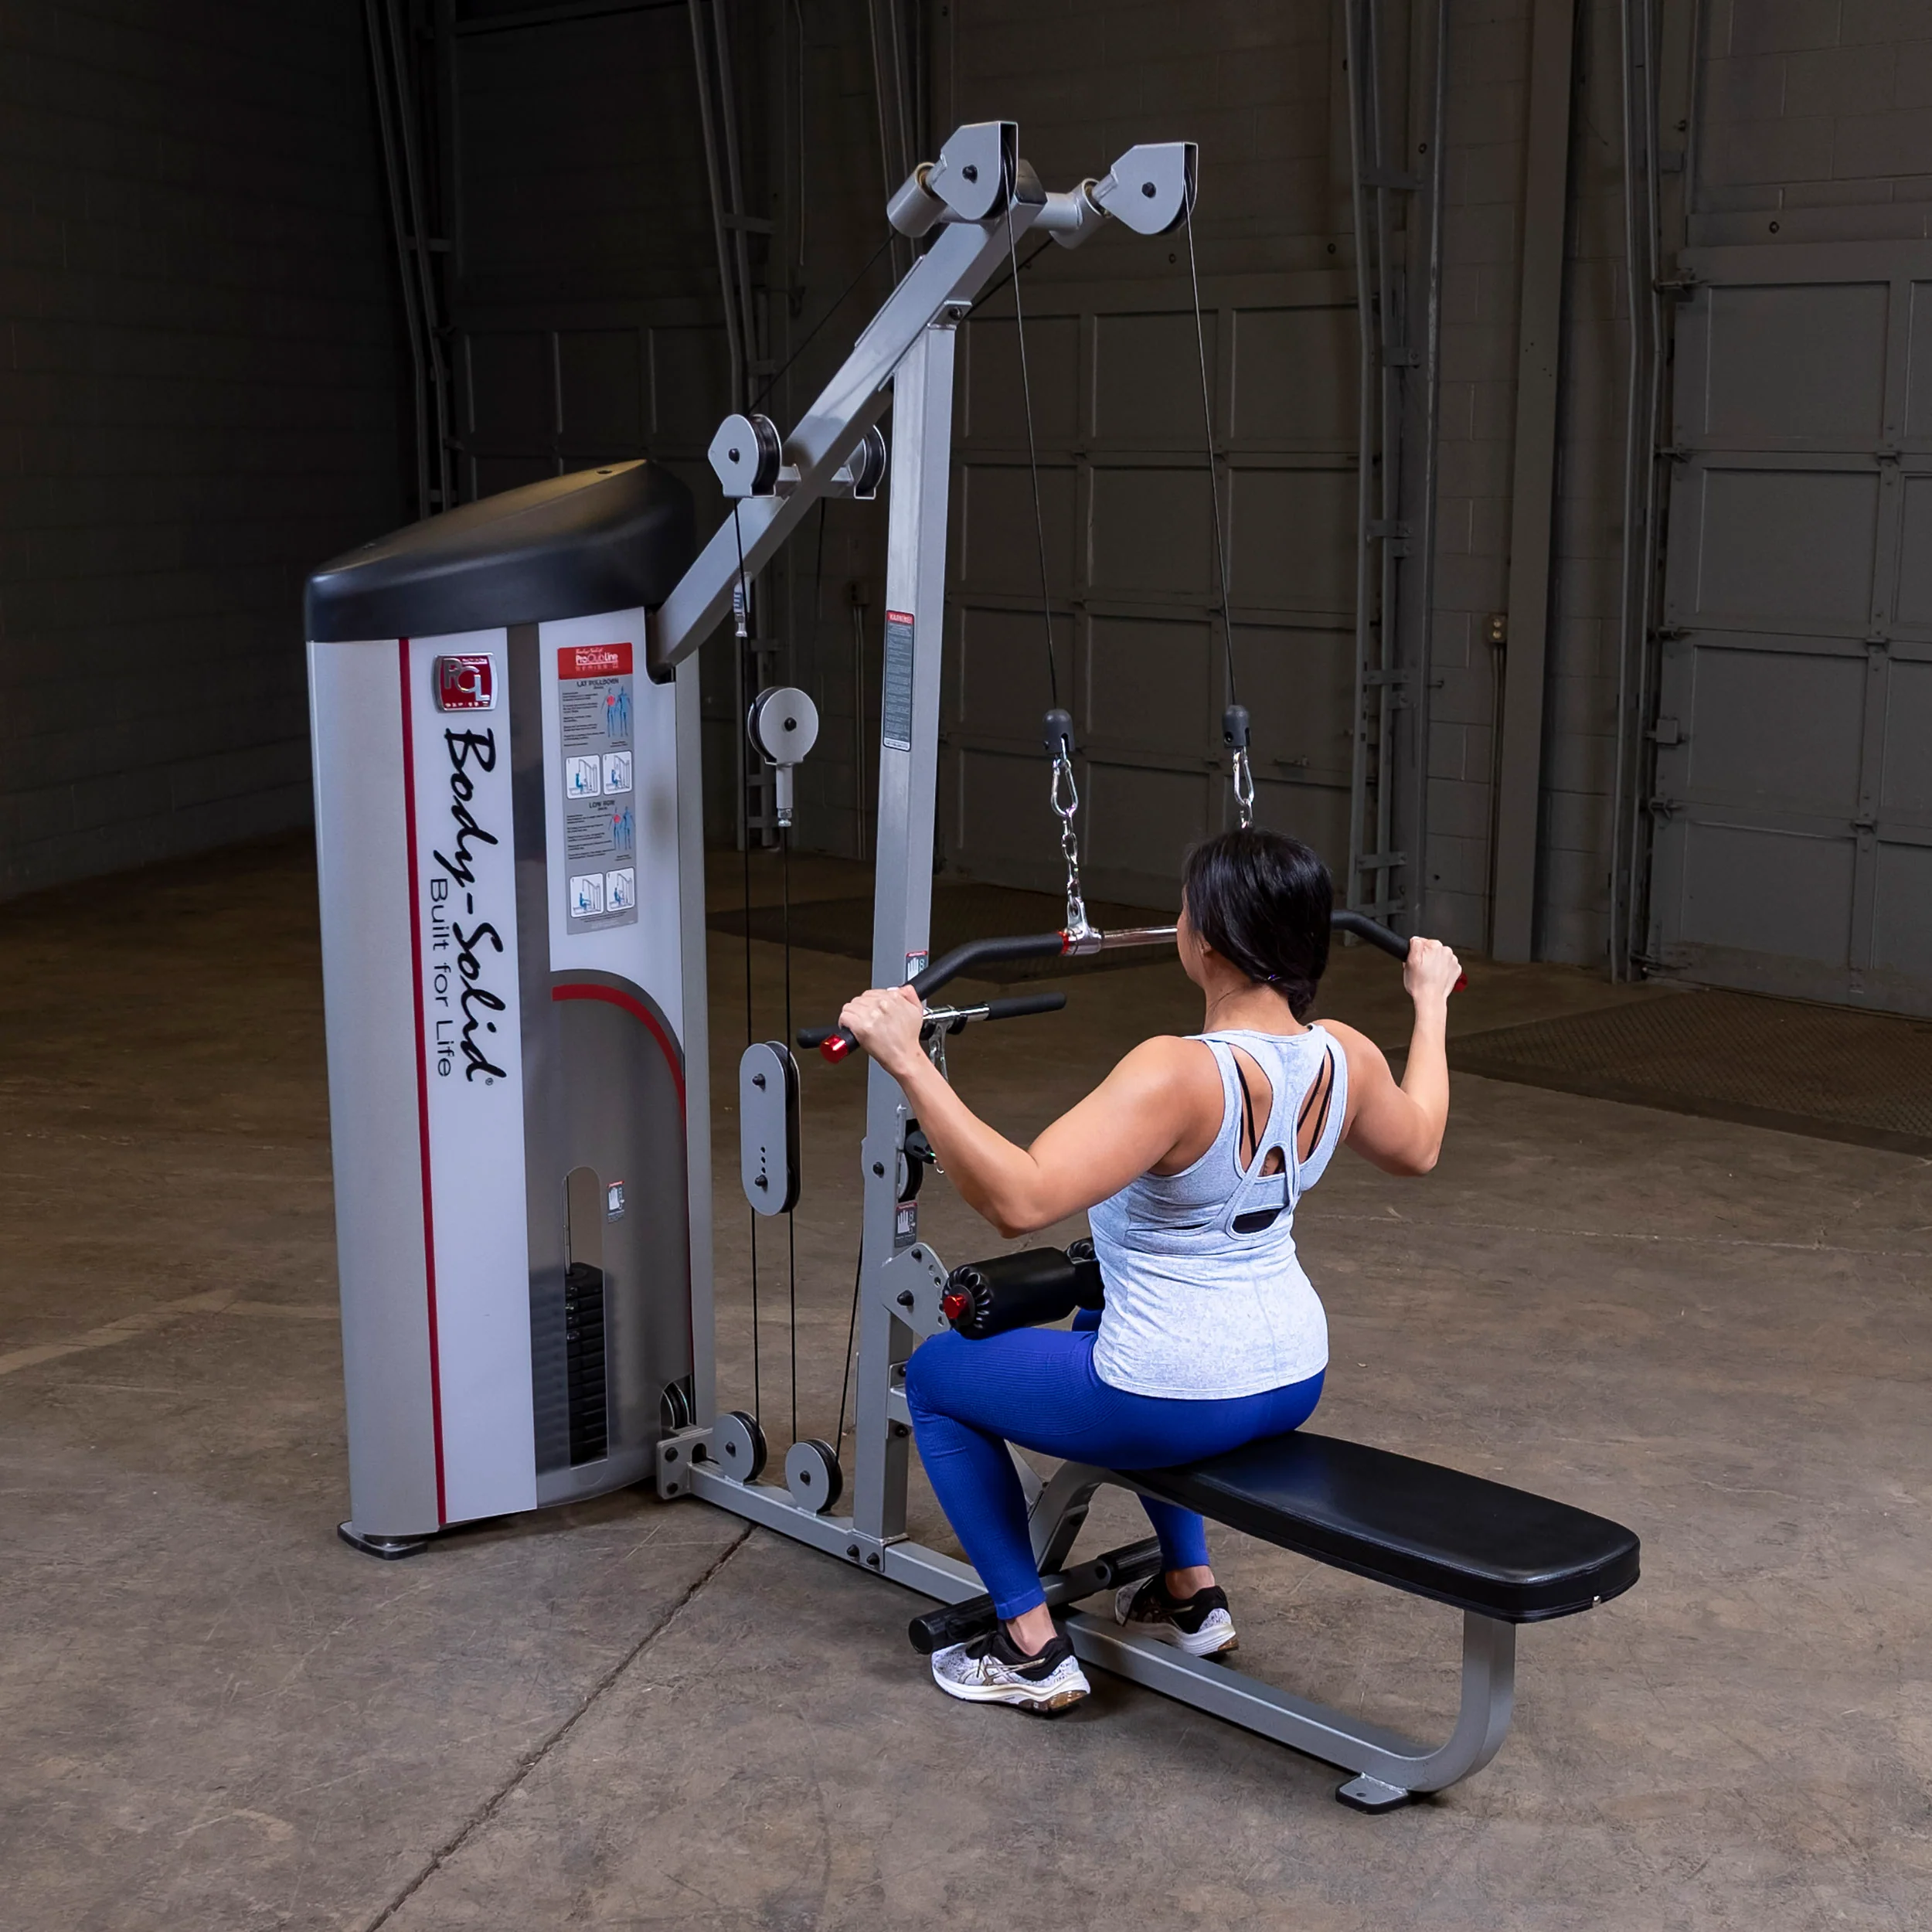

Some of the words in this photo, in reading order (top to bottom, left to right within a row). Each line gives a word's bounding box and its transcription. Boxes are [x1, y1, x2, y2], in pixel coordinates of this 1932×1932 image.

[430, 878, 450, 951] Built
[434, 963, 451, 1007] for
[437, 1019, 454, 1077] Life
